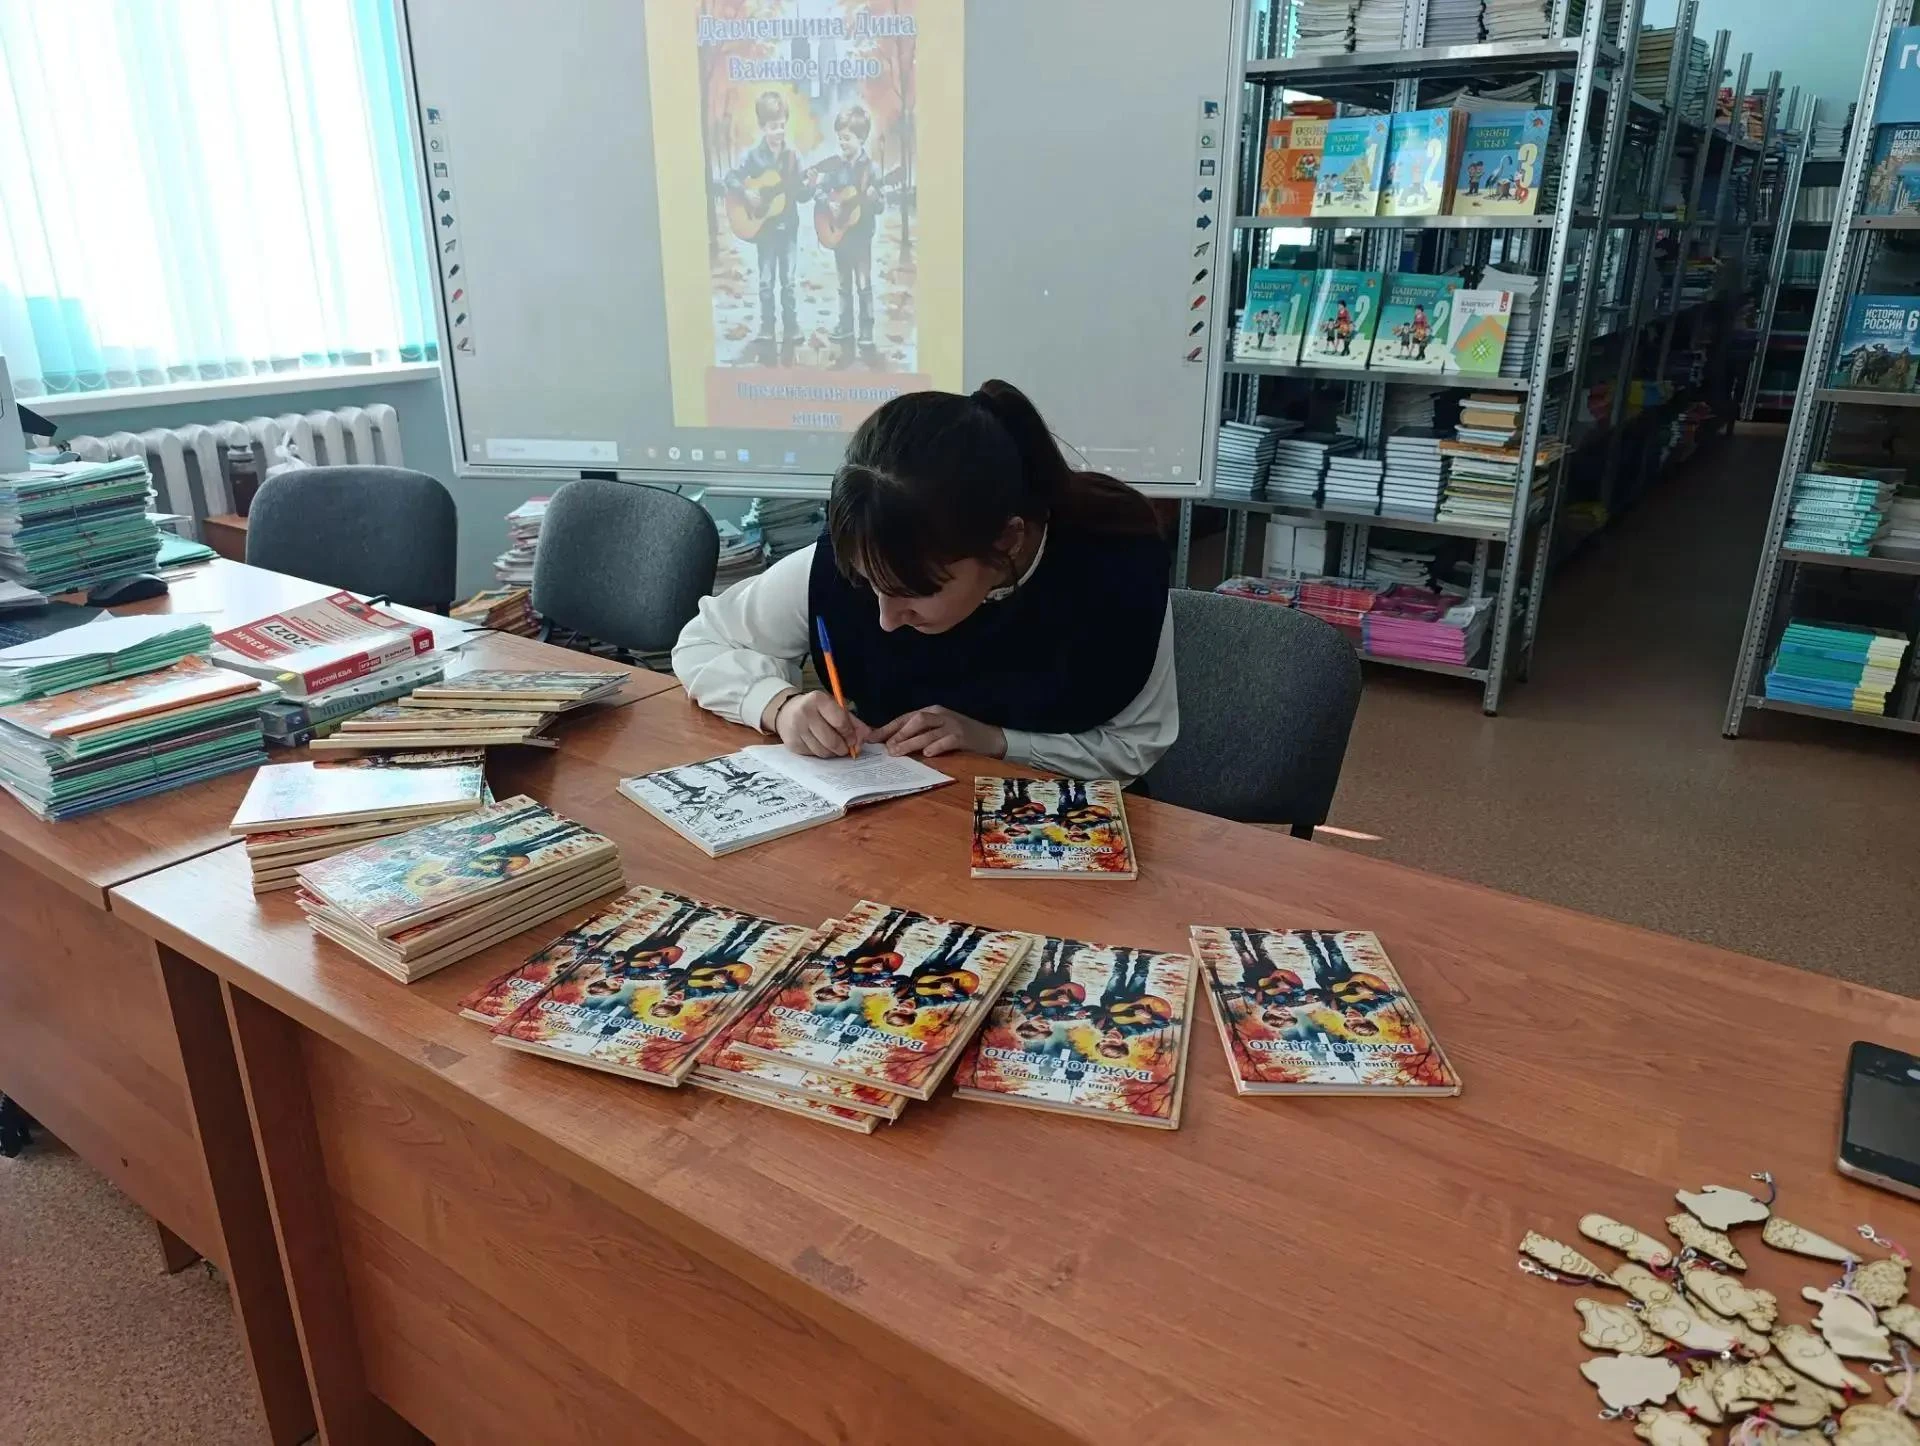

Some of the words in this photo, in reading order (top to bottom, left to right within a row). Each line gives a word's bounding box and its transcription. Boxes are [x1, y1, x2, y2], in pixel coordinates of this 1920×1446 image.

[852, 12, 917, 41] Дина
[728, 56, 818, 81] Важное
[823, 58, 881, 83] дело
[1423, 138, 1442, 196] 2
[1518, 143, 1538, 188] 3
[1286, 293, 1301, 335] 1
[1352, 295, 1370, 340] 2
[1431, 300, 1450, 340] 2
[1863, 318, 1903, 329] РОССИИ
[1866, 309, 1905, 319] ИСТОРИЯ
[1907, 310, 1920, 331] 6
[312, 673, 338, 687] РУССКИЙ
[539, 1000, 599, 1021] ДЕЛО
[771, 1006, 829, 1028] ДЕЛО
[596, 1013, 686, 1041] ВАЖНОЕ
[829, 1020, 926, 1052] ВАЖНОЕ
[615, 1038, 646, 1051] Дина
[856, 1046, 887, 1061] Дина
[1248, 1039, 1311, 1053] ДЕЛО
[1317, 1041, 1416, 1054] ВАЖНОЕ
[983, 1047, 1048, 1066] ДЕЛО
[1365, 1060, 1399, 1069] Дина
[1050, 1057, 1153, 1082] ВАЖНОЕ
[1088, 1082, 1124, 1095] Дина
